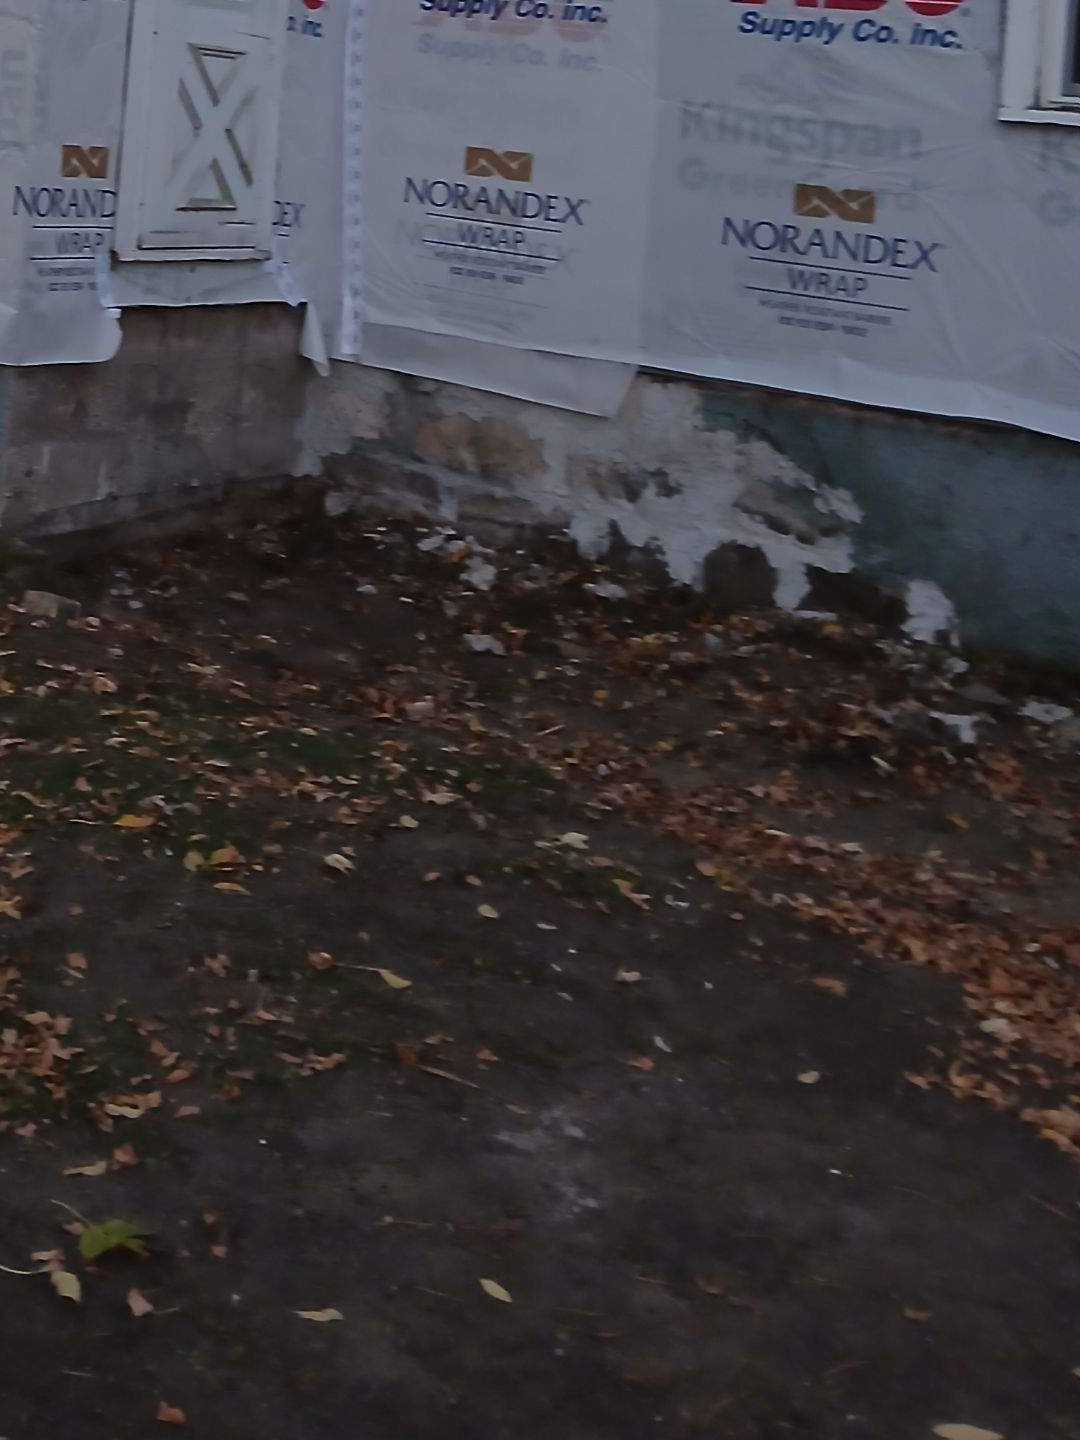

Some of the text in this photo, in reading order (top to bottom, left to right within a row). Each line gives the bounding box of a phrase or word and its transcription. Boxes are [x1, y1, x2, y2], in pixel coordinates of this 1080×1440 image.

[737, 10, 844, 45] Supply
[852, 18, 900, 44] Co.
[12, 185, 118, 219] NORAND
[403, 177, 591, 226] NORANDEX
[458, 223, 525, 250] WRAP
[720, 216, 951, 273] NORANDEX
[787, 268, 869, 298] WRAP
